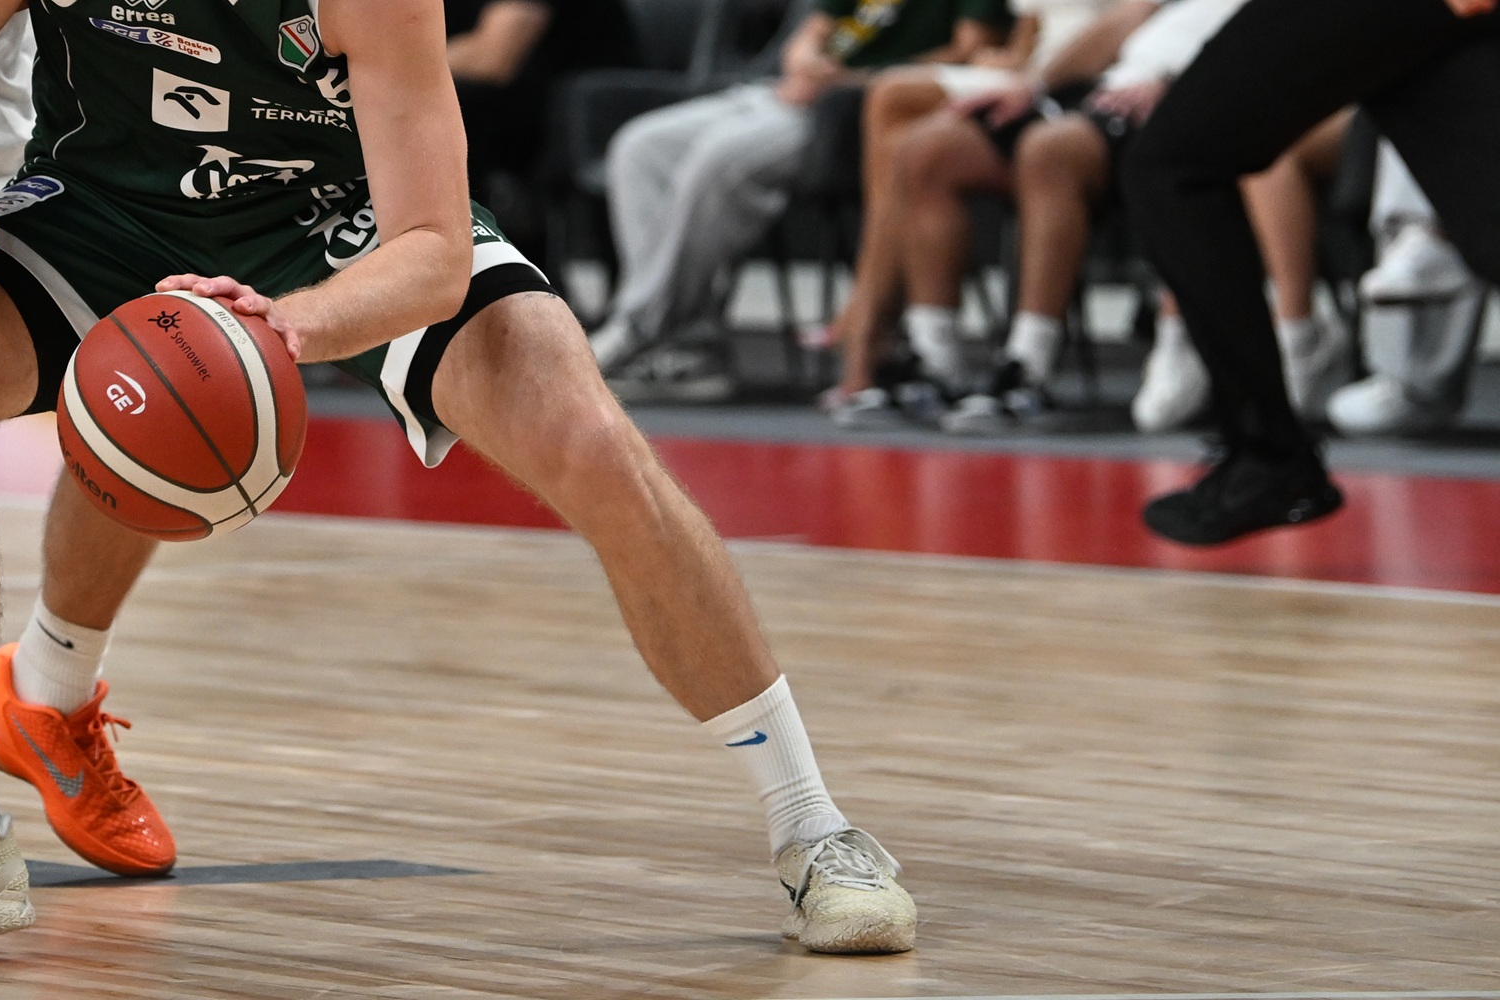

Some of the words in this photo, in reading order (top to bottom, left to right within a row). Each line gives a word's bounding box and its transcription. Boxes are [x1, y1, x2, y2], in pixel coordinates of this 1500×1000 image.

[177, 37, 213, 53] Basket
[178, 43, 200, 56] Liga
[251, 107, 353, 133] TERMIKA
[170, 331, 212, 383] Sosnowiec
